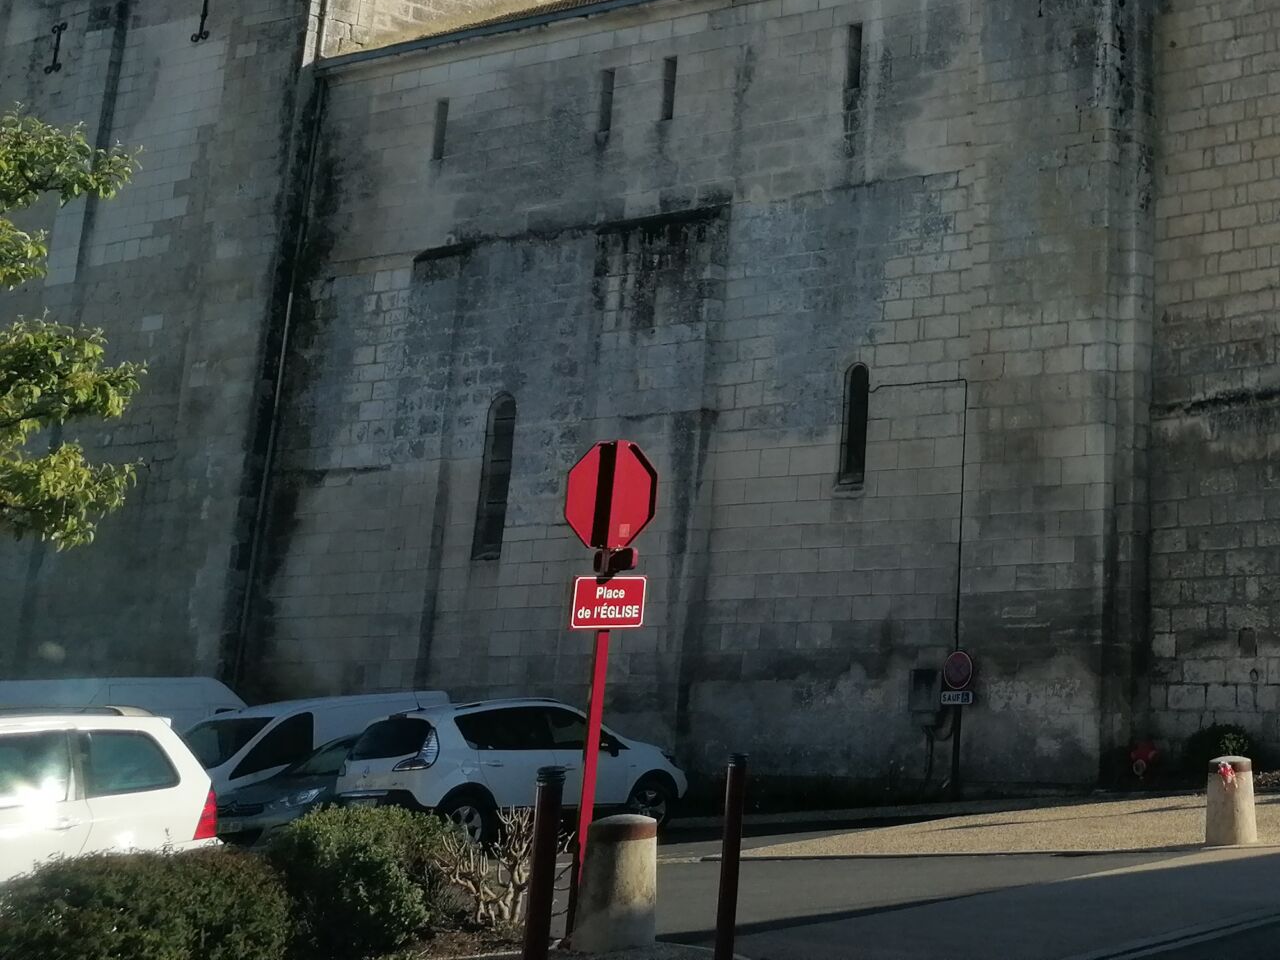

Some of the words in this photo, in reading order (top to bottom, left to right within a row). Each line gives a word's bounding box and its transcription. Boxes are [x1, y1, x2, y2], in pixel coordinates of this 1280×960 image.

[596, 586, 625, 599] Place
[577, 606, 591, 619] de
[594, 602, 640, 619] l'ÉGLISE
[942, 693, 961, 702] SAUF
